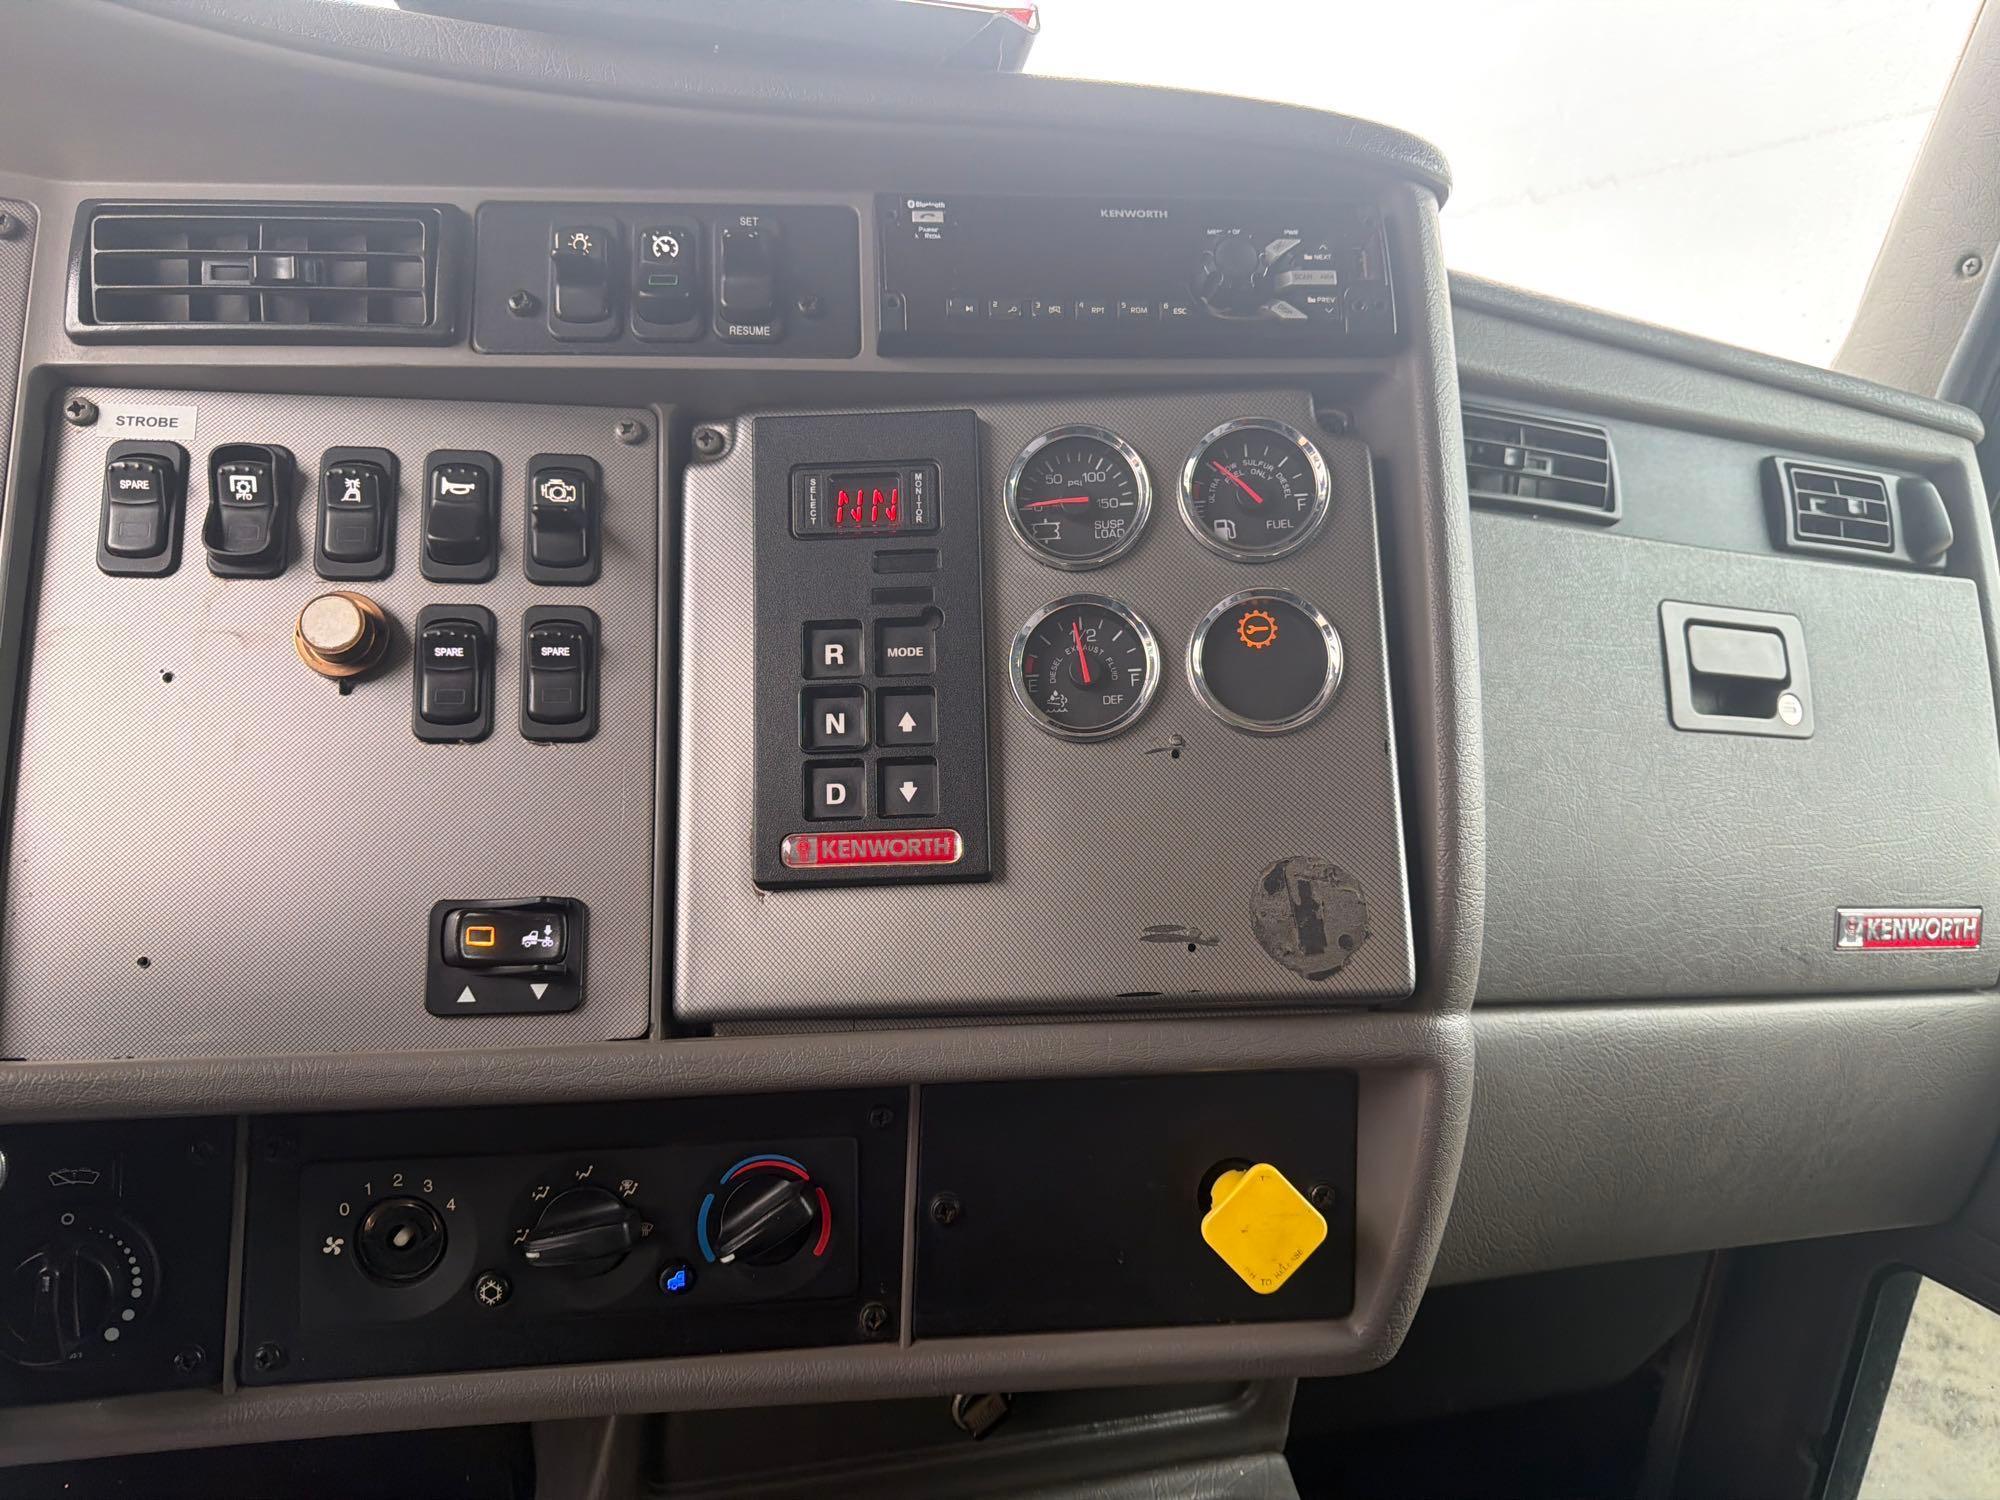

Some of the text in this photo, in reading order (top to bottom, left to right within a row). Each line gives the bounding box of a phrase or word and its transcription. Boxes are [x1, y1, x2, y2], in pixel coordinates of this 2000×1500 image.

[1100, 208, 1168, 219] KENWORTH
[739, 216, 759, 227] SET
[992, 300, 999, 308] 2
[1316, 296, 1337, 304] PREV
[1173, 307, 1188, 315] ESC
[729, 325, 770, 336] RESUME
[115, 415, 179, 428] STROBE
[1045, 473, 1063, 485] 50
[1082, 471, 1106, 483] 100
[1250, 468, 1273, 481] ONLY
[119, 479, 150, 490] SPARE
[1067, 480, 1083, 488] PSI
[1208, 478, 1220, 504] ULTRA
[1242, 459, 1274, 472] SULFUR
[1275, 472, 1292, 499] DIESEL
[235, 492, 252, 501] PTO
[809, 478, 817, 526] SELECT
[914, 472, 923, 524] MONITOR
[1098, 497, 1119, 509] 150
[1297, 498, 1307, 511] F
[1094, 519, 1125, 530] SUSP
[1266, 519, 1294, 529] FUEL
[1094, 529, 1125, 539] LOAD
[434, 647, 464, 657] SPARE
[540, 646, 570, 657] SPARE
[824, 644, 844, 665] R
[887, 647, 924, 658] MODE
[1049, 644, 1119, 684] DIESEL EXAUST FLUID
[1028, 679, 1039, 693] E
[1130, 673, 1140, 687] F
[1102, 694, 1124, 705] DEF
[825, 713, 845, 735] N
[826, 783, 846, 805] D
[821, 837, 949, 859] KENWORTH
[1866, 917, 1978, 940] KENWORTH
[392, 1173, 403, 1187] 2
[423, 1179, 433, 1193] 3
[364, 1182, 371, 1196] 1
[339, 1202, 350, 1216] 0
[446, 1198, 456, 1212] 4
